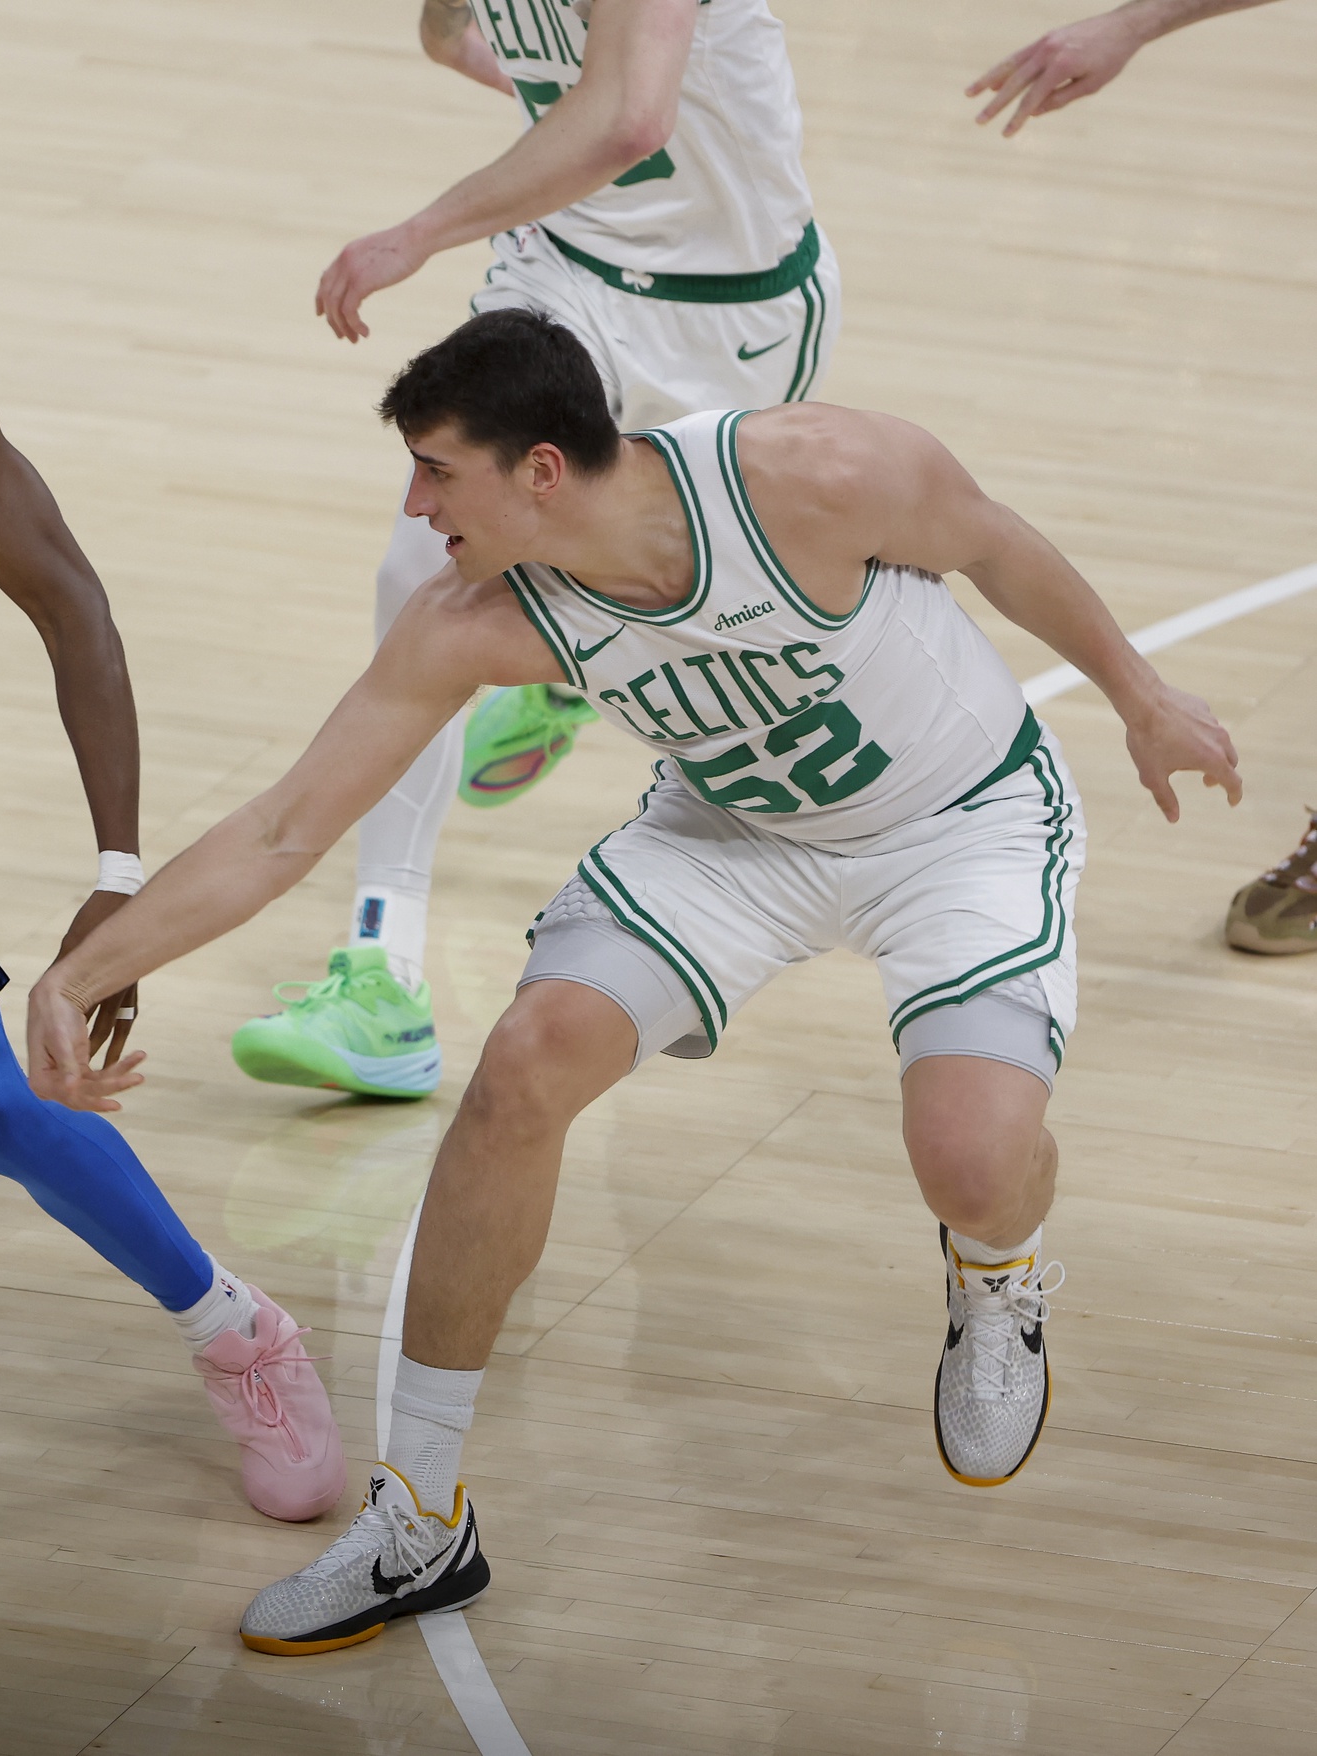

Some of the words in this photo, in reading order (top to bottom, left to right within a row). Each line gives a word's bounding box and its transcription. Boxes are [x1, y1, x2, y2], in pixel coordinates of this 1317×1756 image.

[714, 600, 776, 631] Amica
[599, 641, 846, 741] CELTICS
[670, 699, 893, 814] 52
